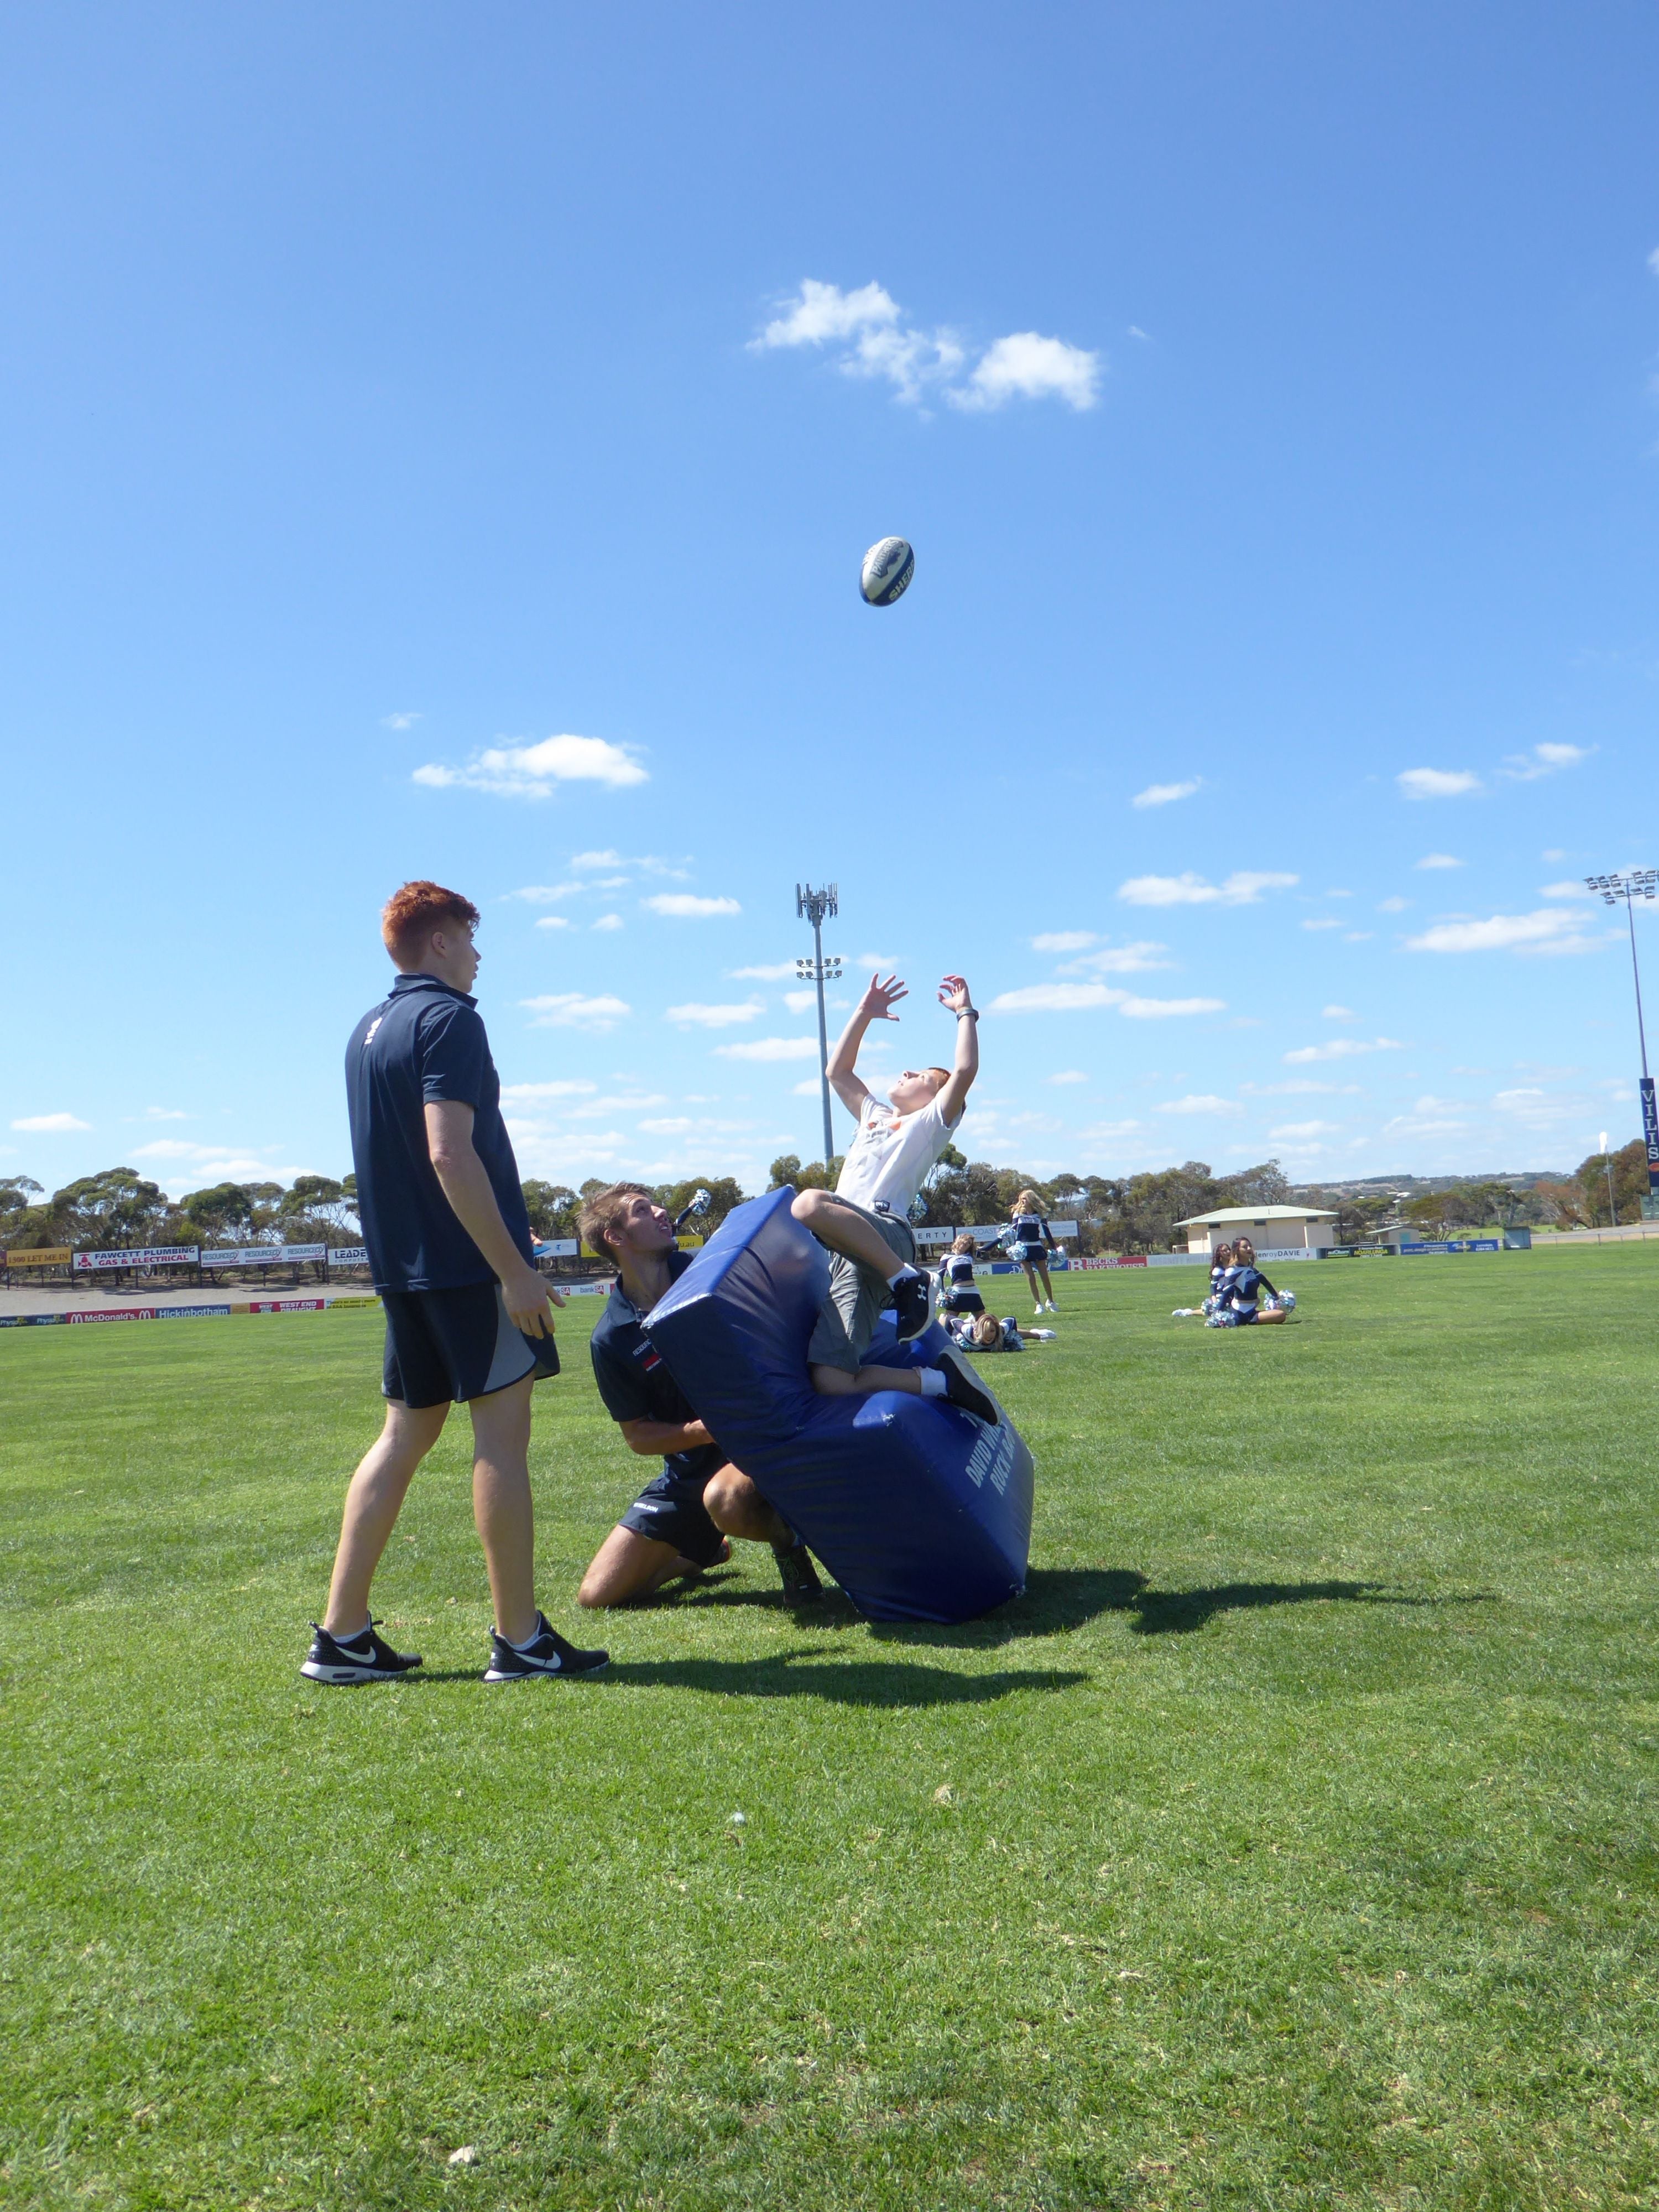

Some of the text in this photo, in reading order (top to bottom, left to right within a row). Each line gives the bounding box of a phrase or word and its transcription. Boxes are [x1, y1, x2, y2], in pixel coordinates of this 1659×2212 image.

[872, 540, 899, 576] PANTHERS
[1641, 1089, 1659, 1160] VILIS
[95, 1247, 195, 1260] FAWCETT PLUMBING
[132, 1255, 189, 1264] ELECTRICAL
[335, 1249, 366, 1259] LEADE
[1256, 1250, 1300, 1259] lenroyDAVIE
[85, 1312, 135, 1322] McDonald's
[159, 1307, 228, 1319] Hickinbotham
[632, 1338, 651, 1357] RESOURC
[965, 1439, 992, 1488] DAVID
[990, 1449, 1011, 1496] RUCK
